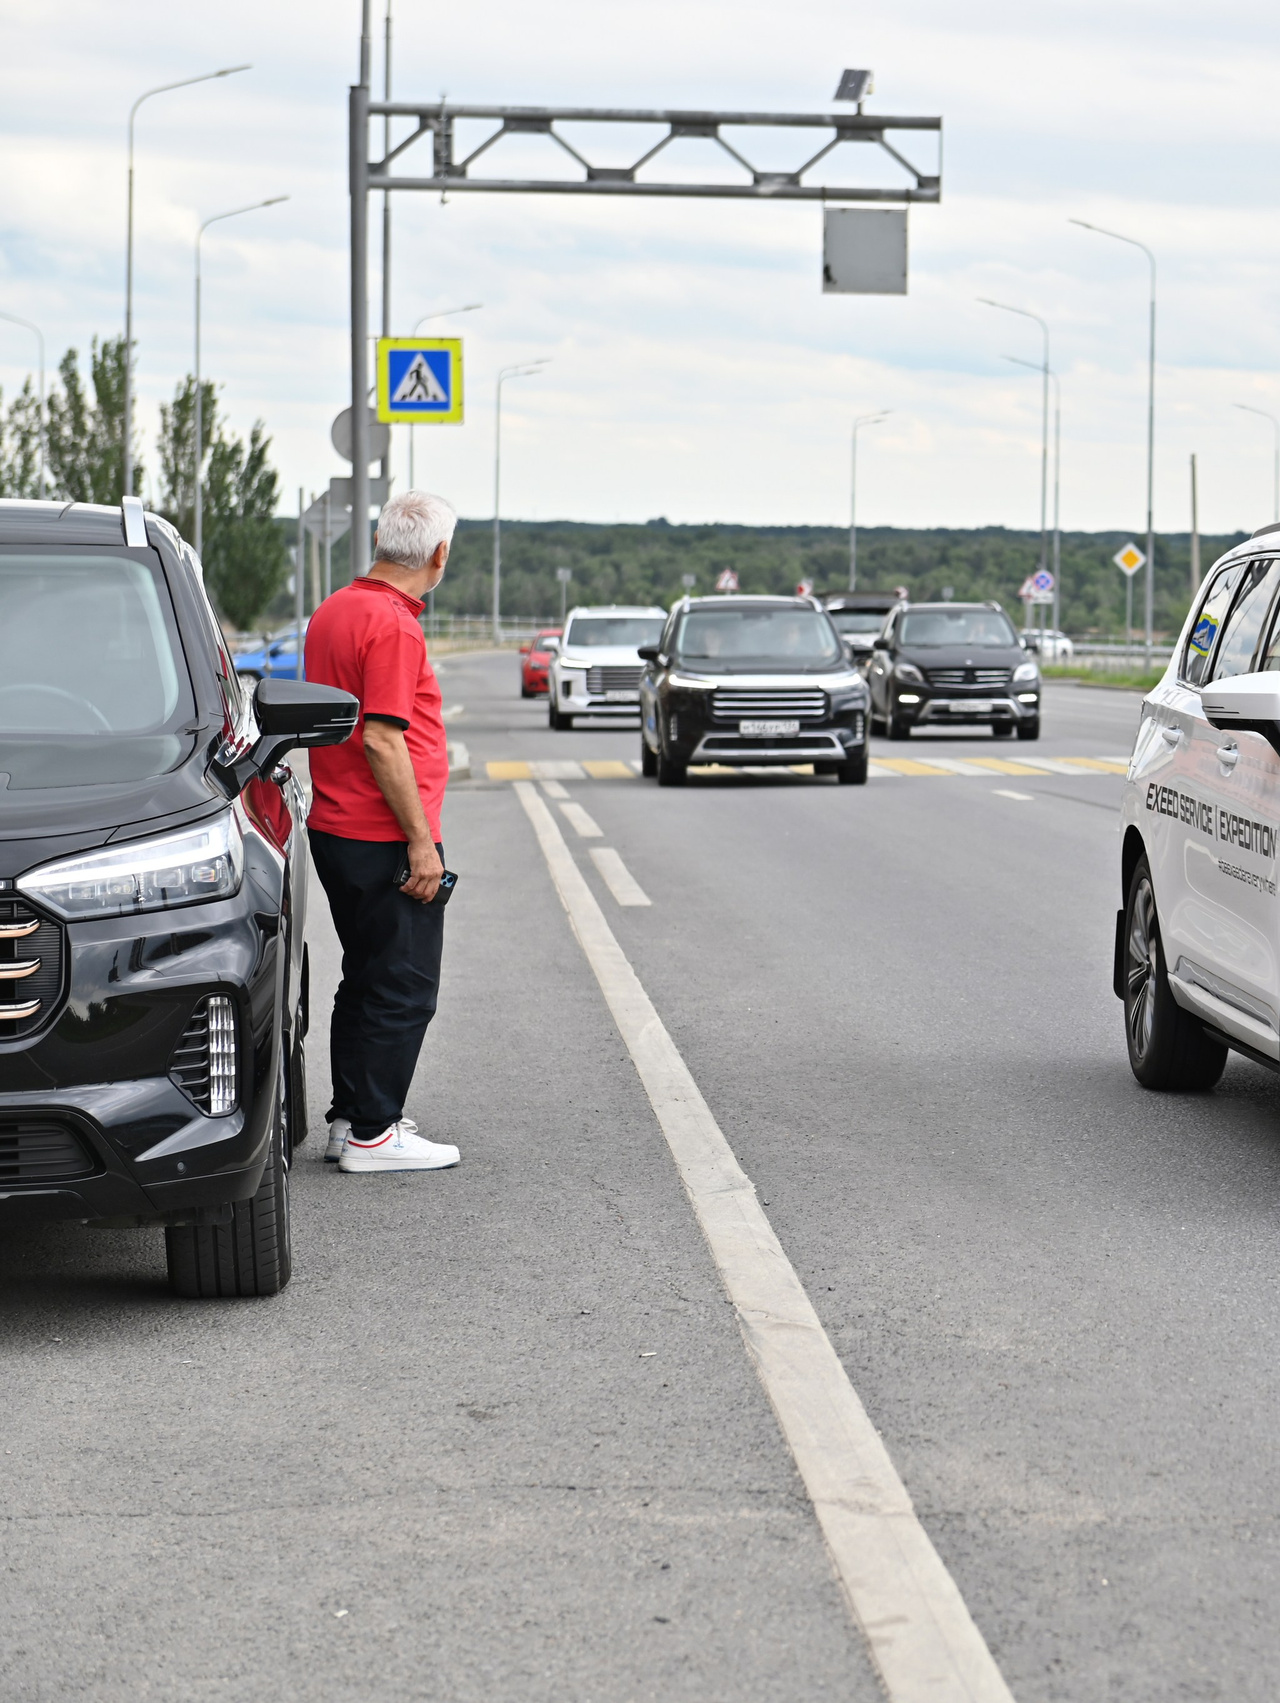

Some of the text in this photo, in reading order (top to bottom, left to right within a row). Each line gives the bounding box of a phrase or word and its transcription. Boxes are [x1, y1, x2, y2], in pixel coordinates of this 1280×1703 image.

[1146, 782, 1179, 819] EXEED
[1179, 794, 1213, 836] SERVICE
[1220, 811, 1278, 860] EXPEDITION
